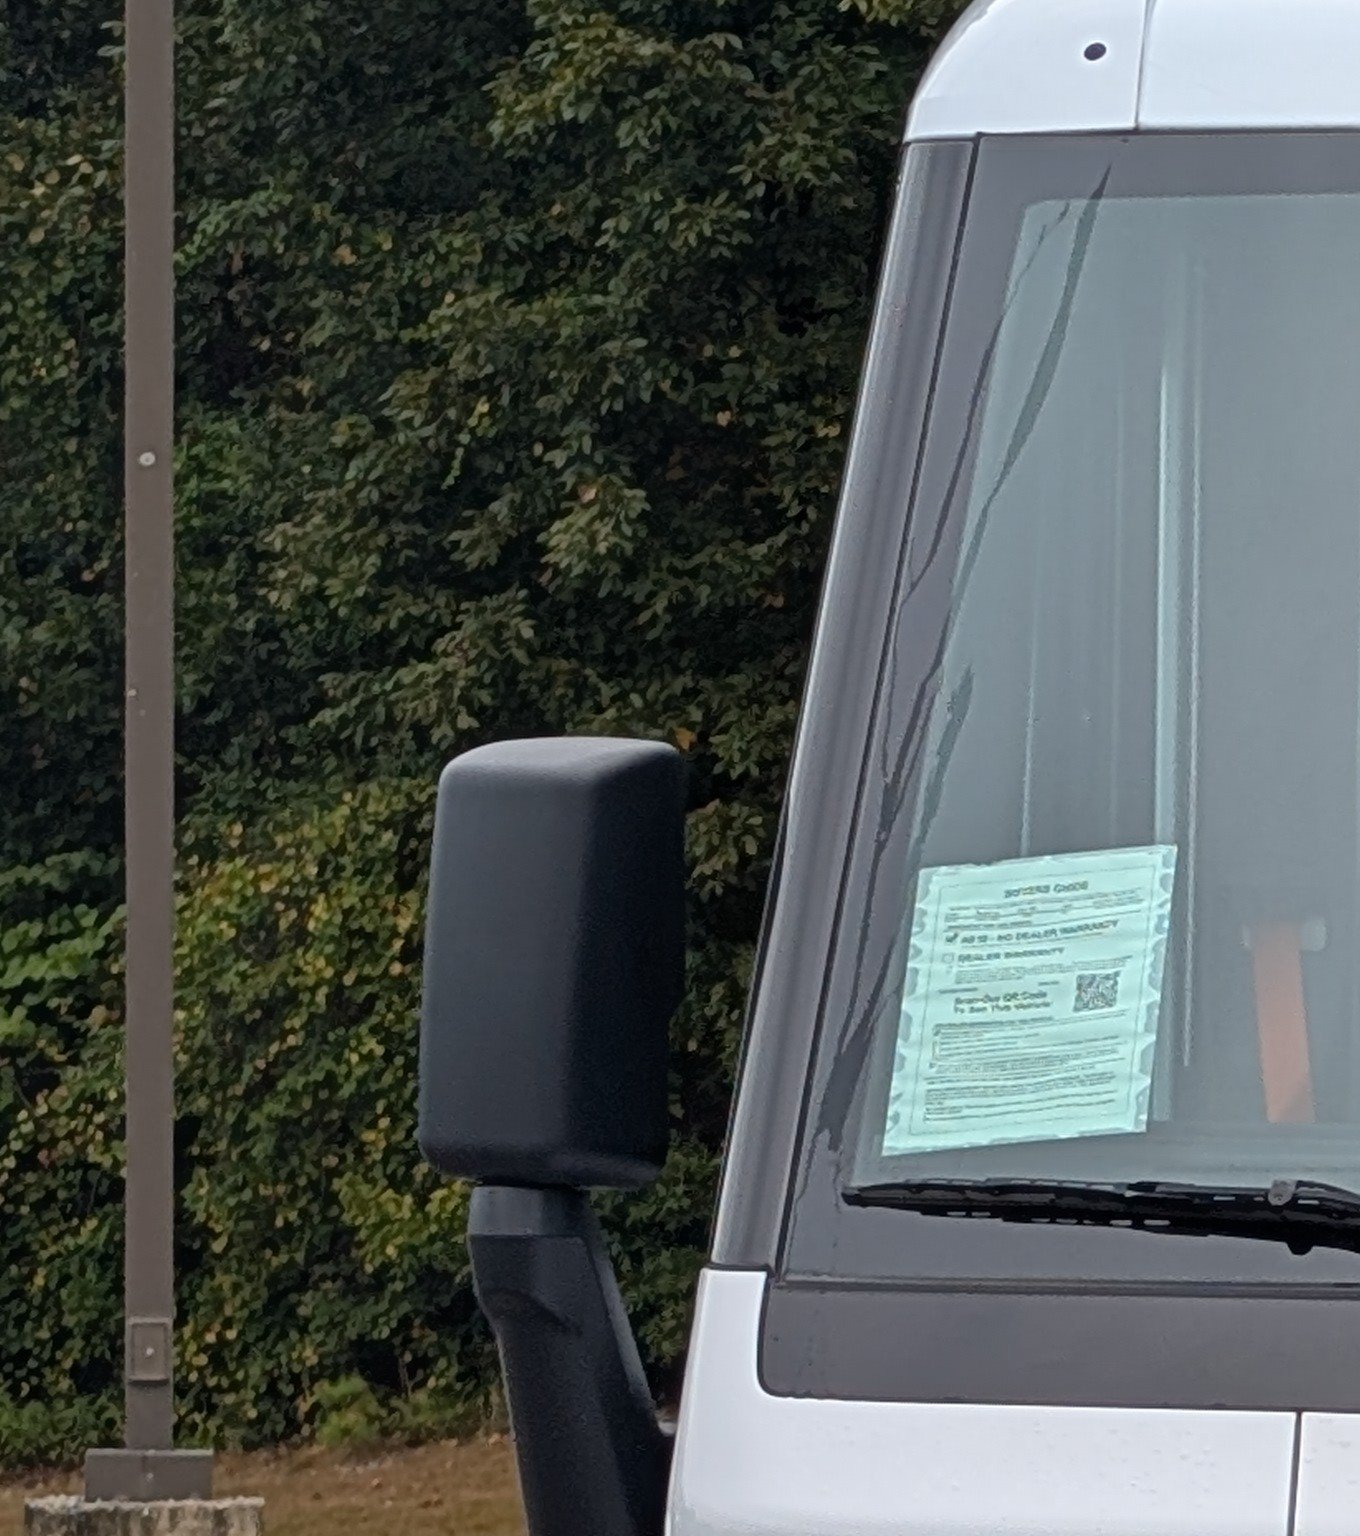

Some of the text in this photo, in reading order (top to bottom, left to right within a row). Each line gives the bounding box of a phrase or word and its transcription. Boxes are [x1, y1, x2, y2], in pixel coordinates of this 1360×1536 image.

[1053, 880, 1088, 893] GUIDE
[997, 932, 1014, 941] NO
[1015, 928, 1058, 941] DEALER
[1060, 919, 1119, 935] WARRANTY
[958, 946, 1065, 963] DEALER WARRANTY
[1003, 991, 1019, 1002] QR
[1020, 990, 1048, 1001] Code
